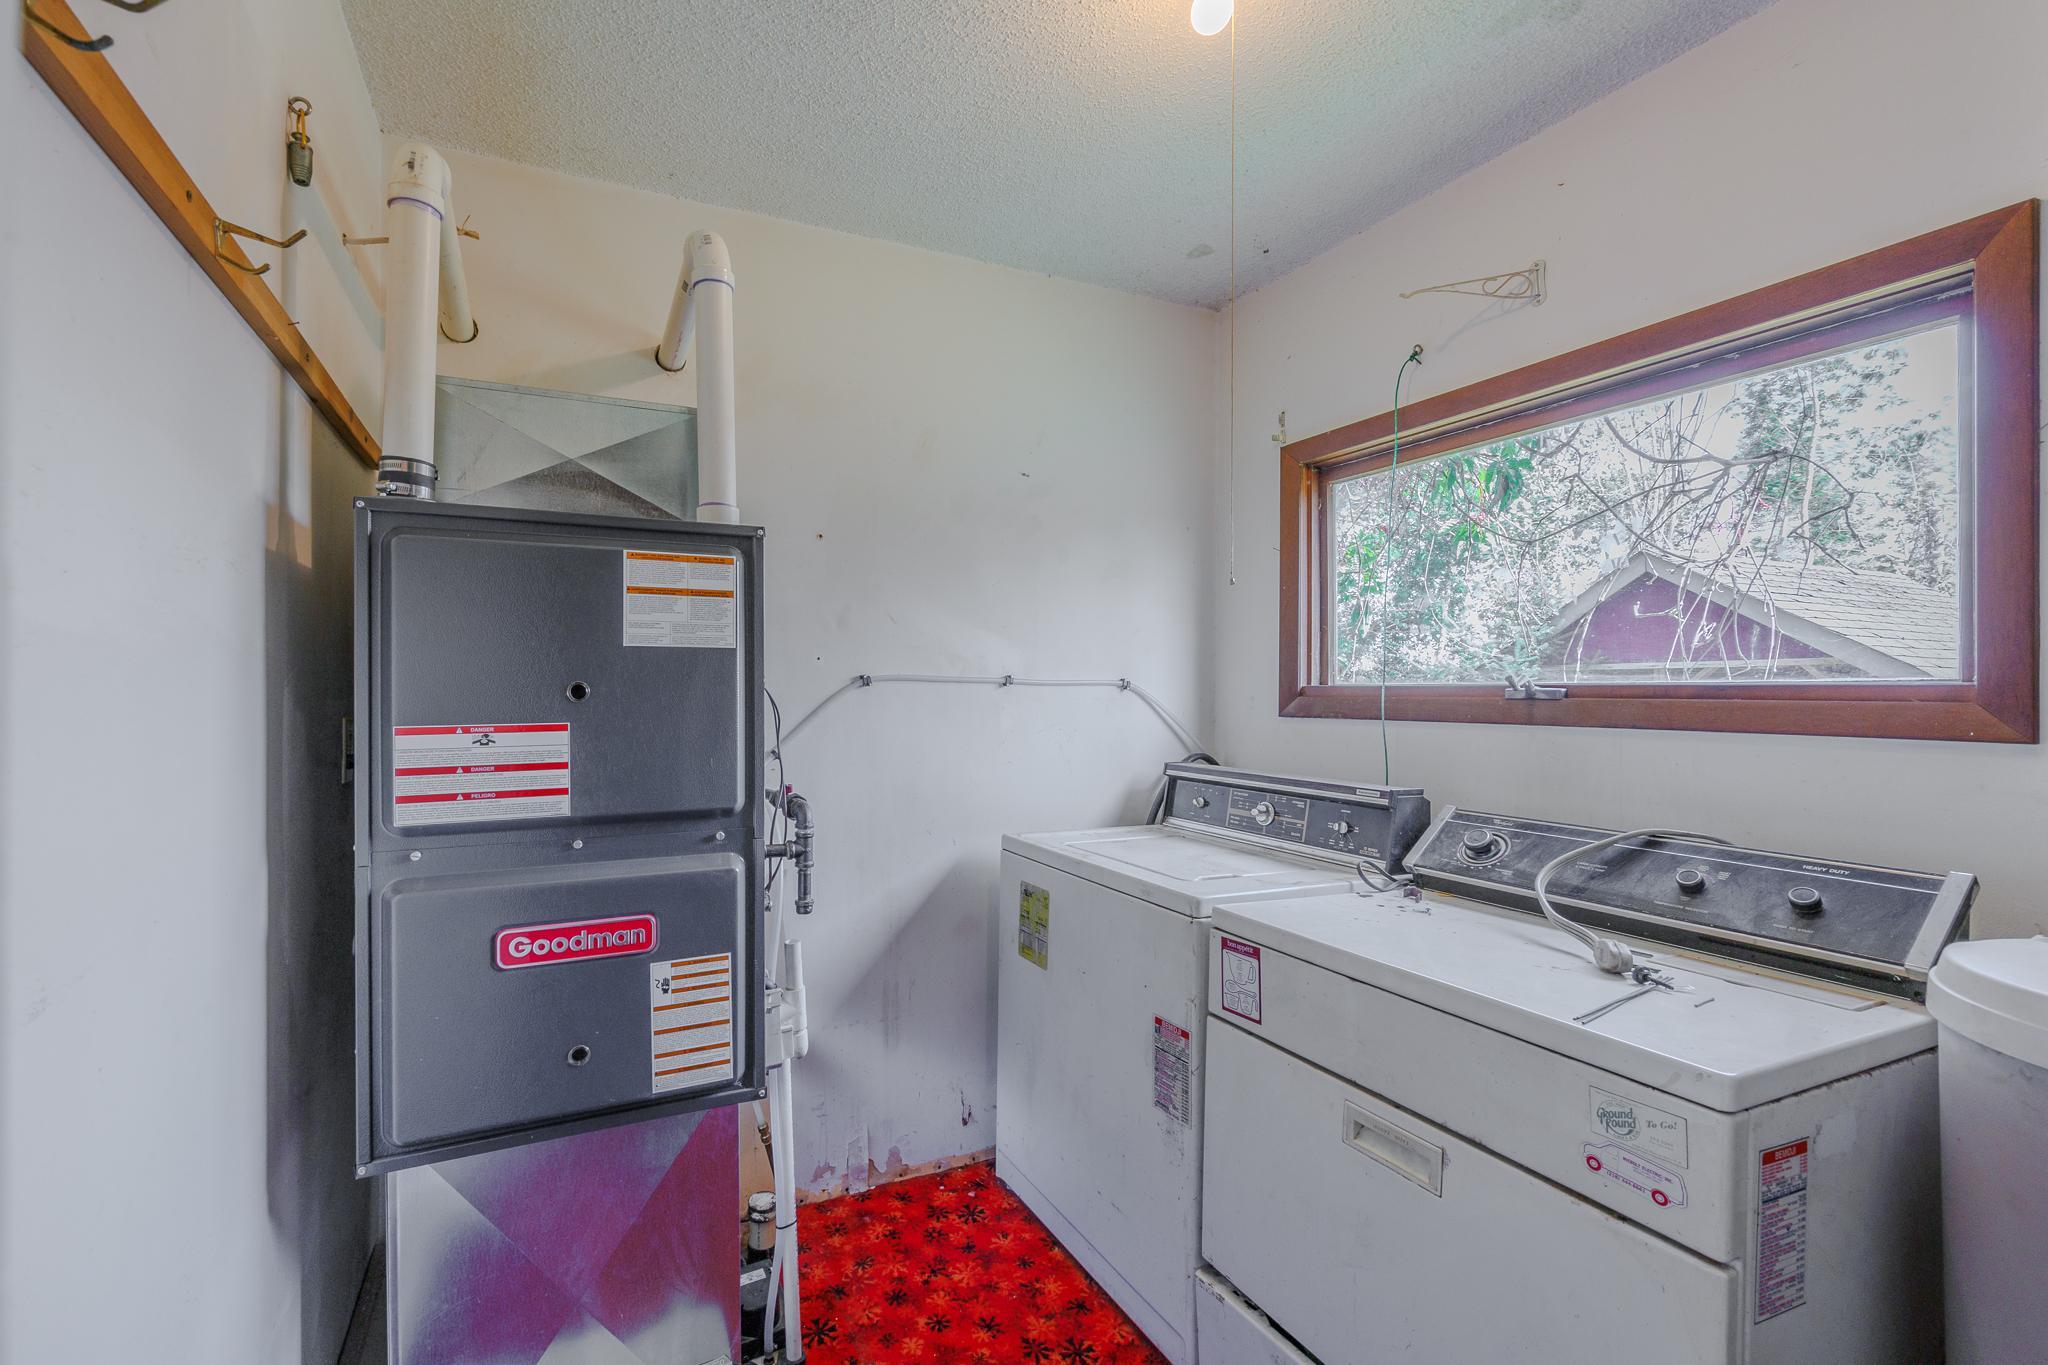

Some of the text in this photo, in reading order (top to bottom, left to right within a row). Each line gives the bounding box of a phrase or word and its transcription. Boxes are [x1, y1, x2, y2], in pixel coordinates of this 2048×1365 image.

[1802, 864, 1828, 873] HEAVY
[508, 928, 646, 958] Goodman
[1596, 1107, 1633, 1125] Ground
[1605, 1116, 1637, 1134] Round
[1646, 1120, 1678, 1130] To Go!
